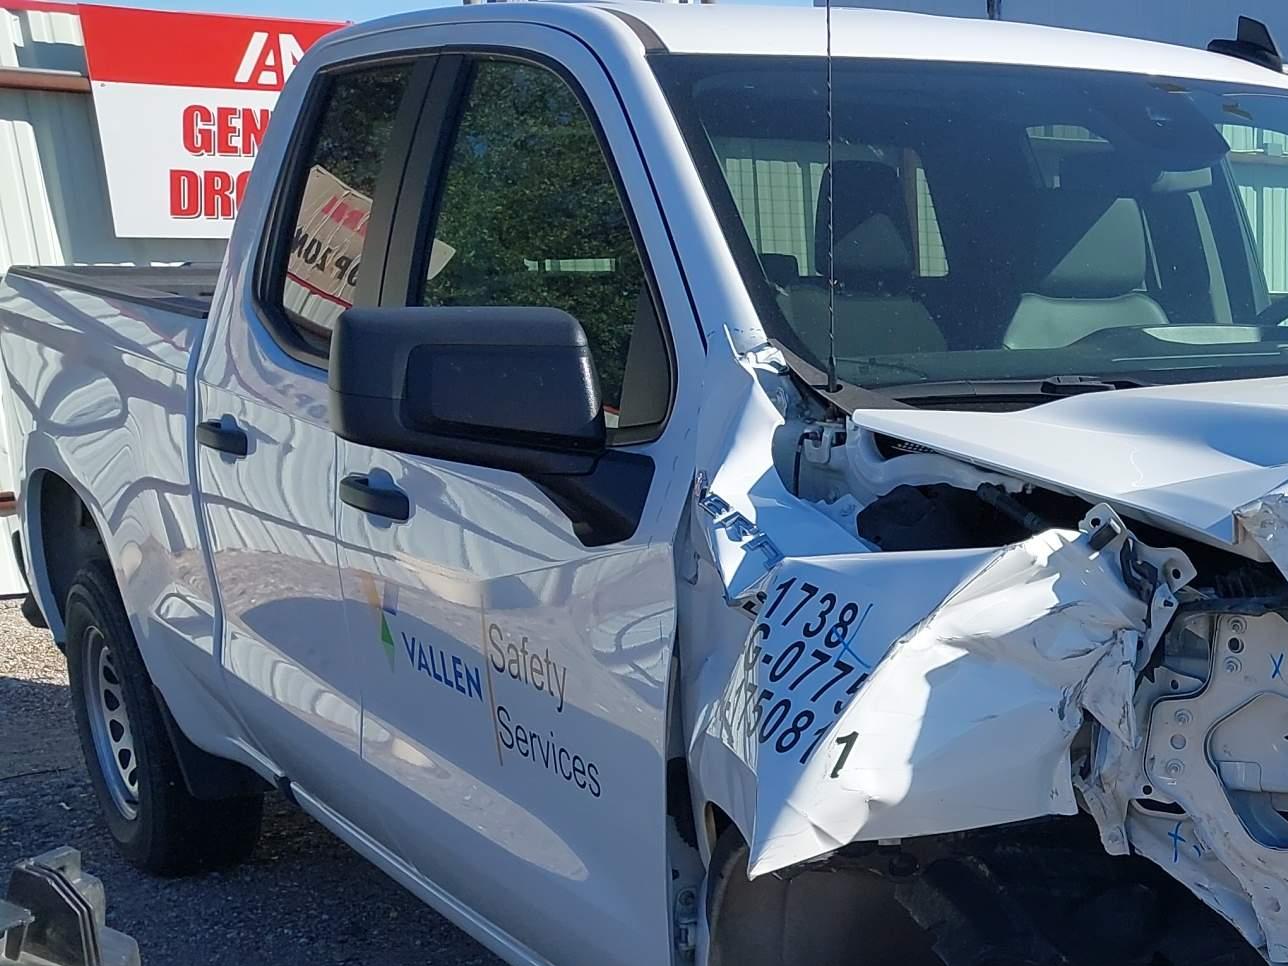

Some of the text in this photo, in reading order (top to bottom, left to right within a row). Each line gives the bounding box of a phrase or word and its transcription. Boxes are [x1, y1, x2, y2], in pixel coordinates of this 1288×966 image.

[401, 631, 484, 703] VALLEN
[489, 622, 567, 713] Safety
[497, 705, 601, 798] Services
